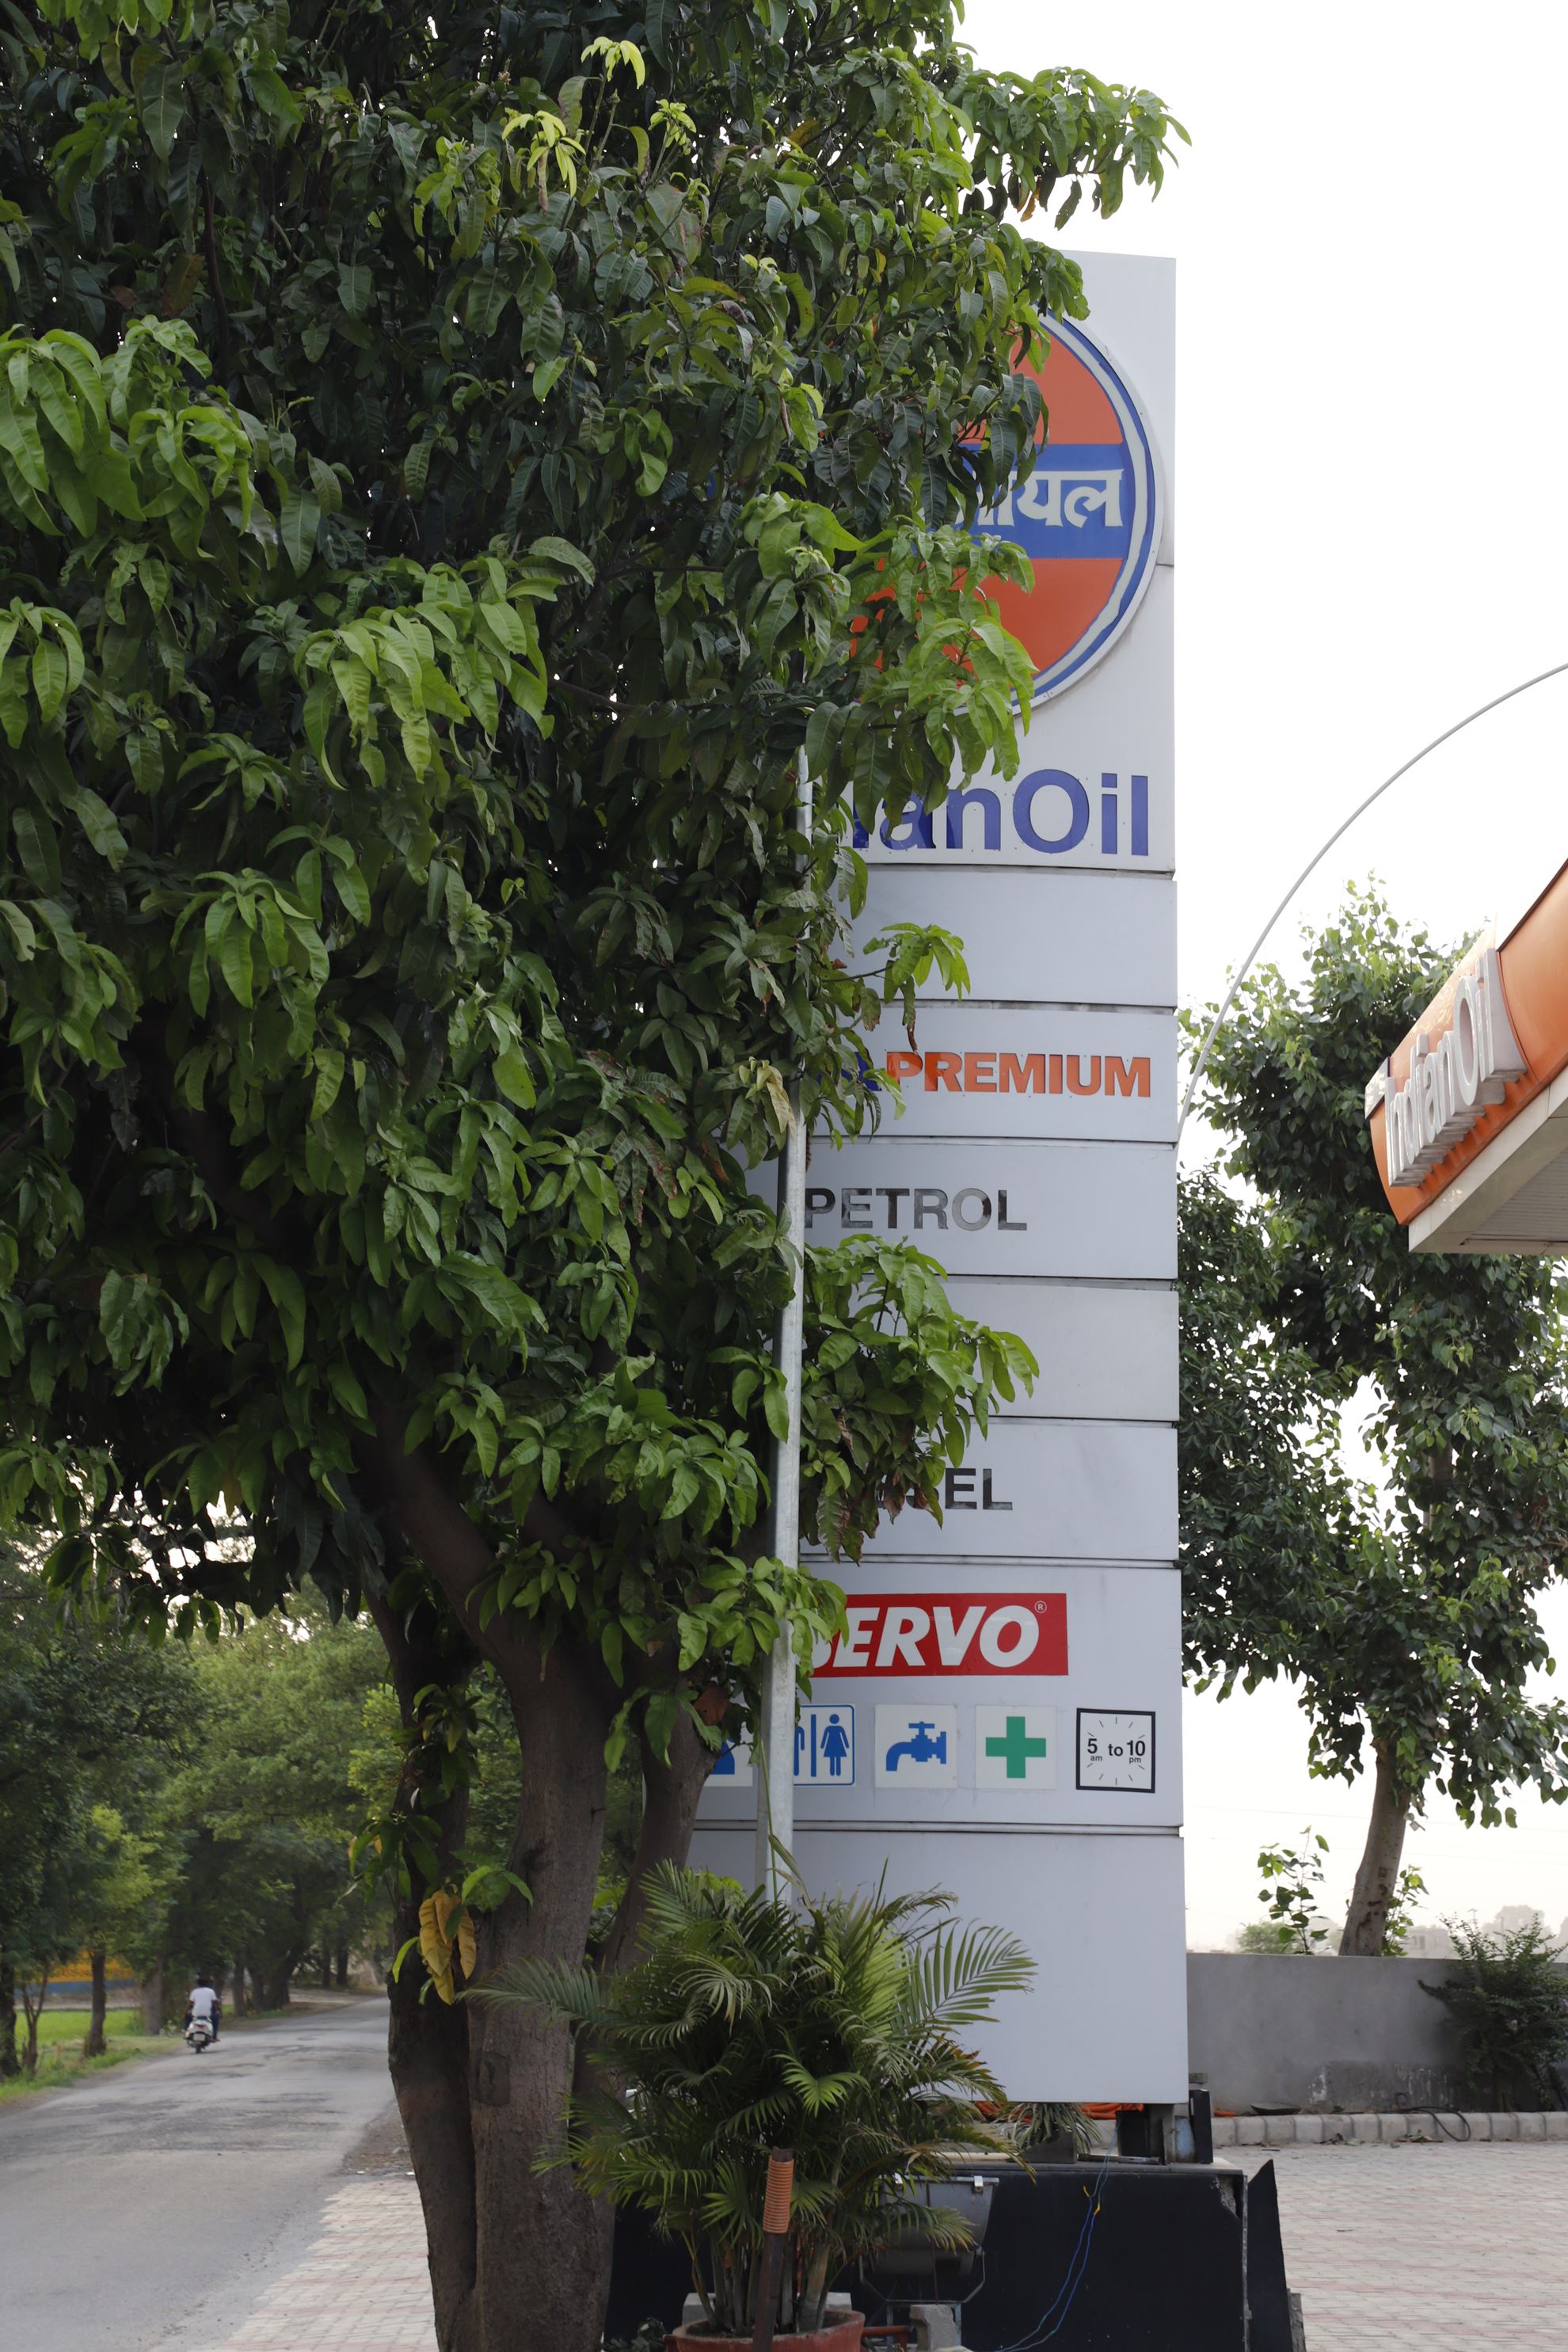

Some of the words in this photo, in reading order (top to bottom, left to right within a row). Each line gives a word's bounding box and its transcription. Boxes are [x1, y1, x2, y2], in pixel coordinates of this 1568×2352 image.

[886, 1051, 1151, 1097] PREMIUM
[1385, 948, 1526, 1186] IndianOil
[804, 1187, 1027, 1231] PETROL
[1087, 1738, 1098, 1754] 5
[1108, 1743, 1124, 1756] to
[1126, 1740, 1146, 1756] 10
